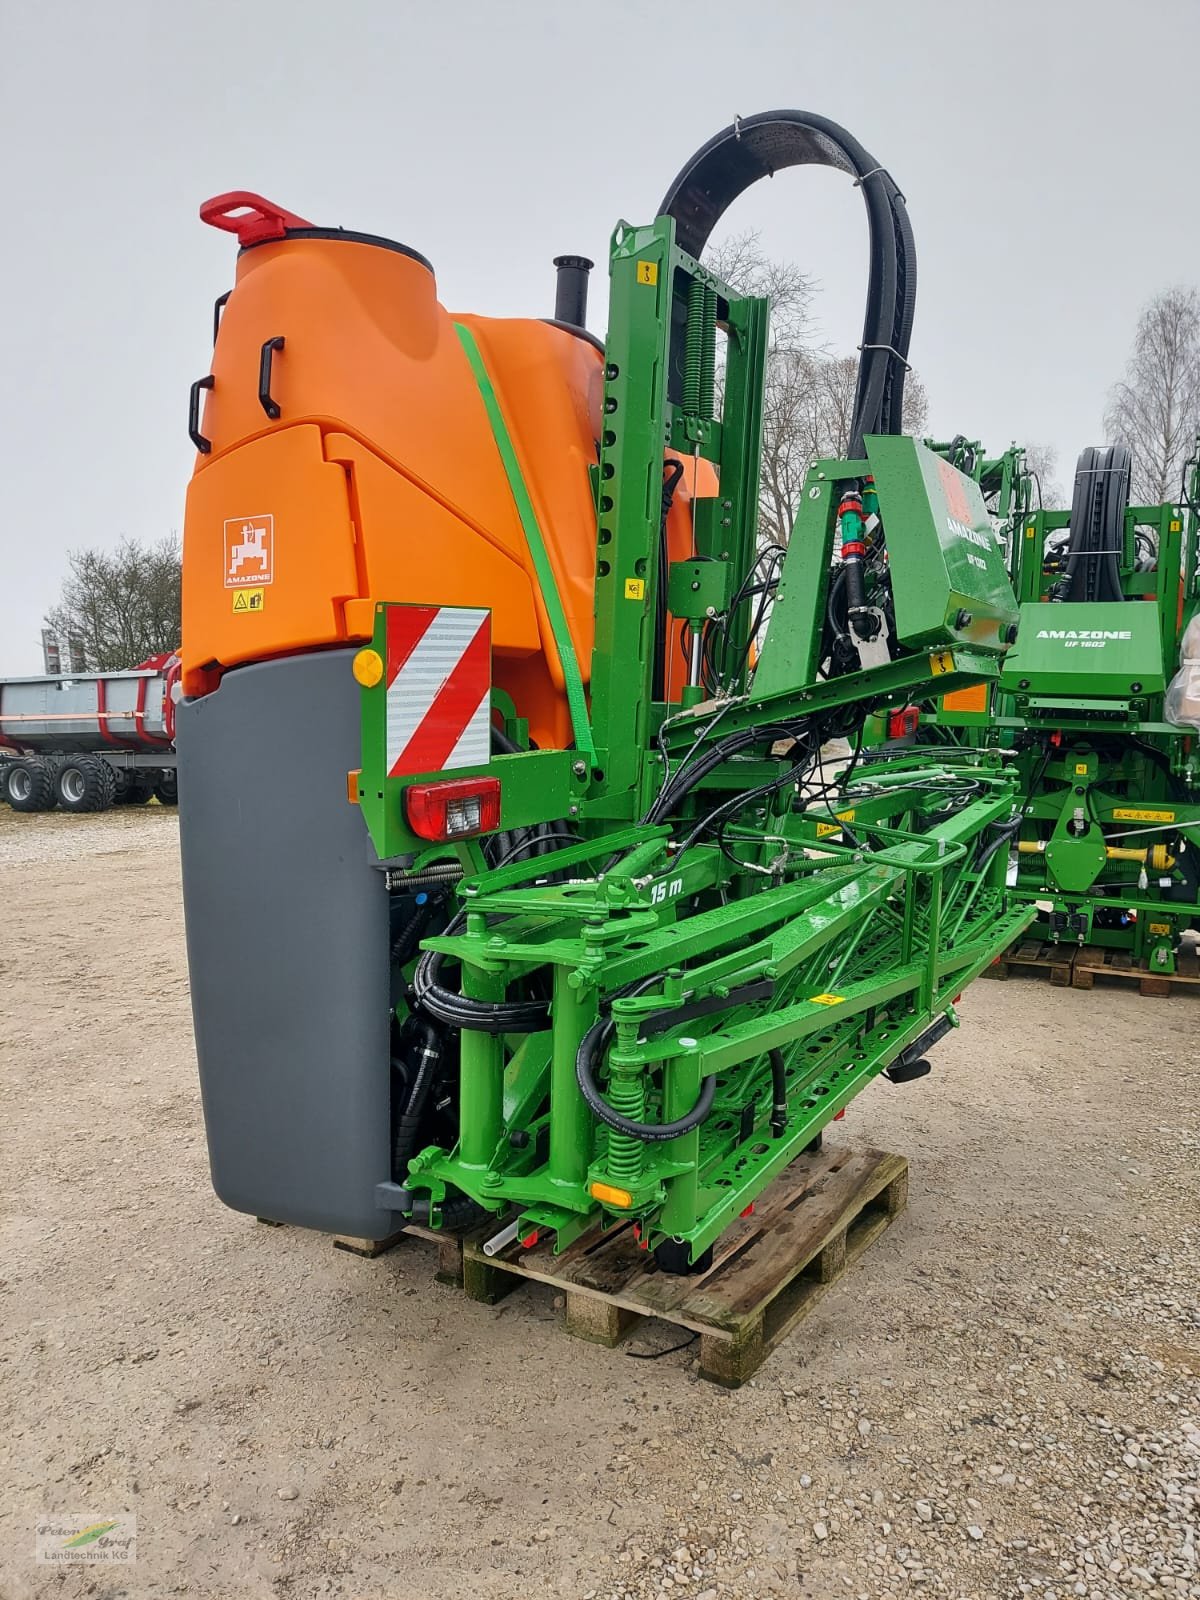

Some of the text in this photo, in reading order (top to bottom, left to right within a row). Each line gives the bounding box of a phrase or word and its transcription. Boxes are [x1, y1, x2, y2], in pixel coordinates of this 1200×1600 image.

[946, 517, 992, 552] AMAZONE
[226, 573, 271, 583] AMAZONE
[1036, 630, 1132, 640] AMAZONE
[651, 878, 683, 905] 15 m
